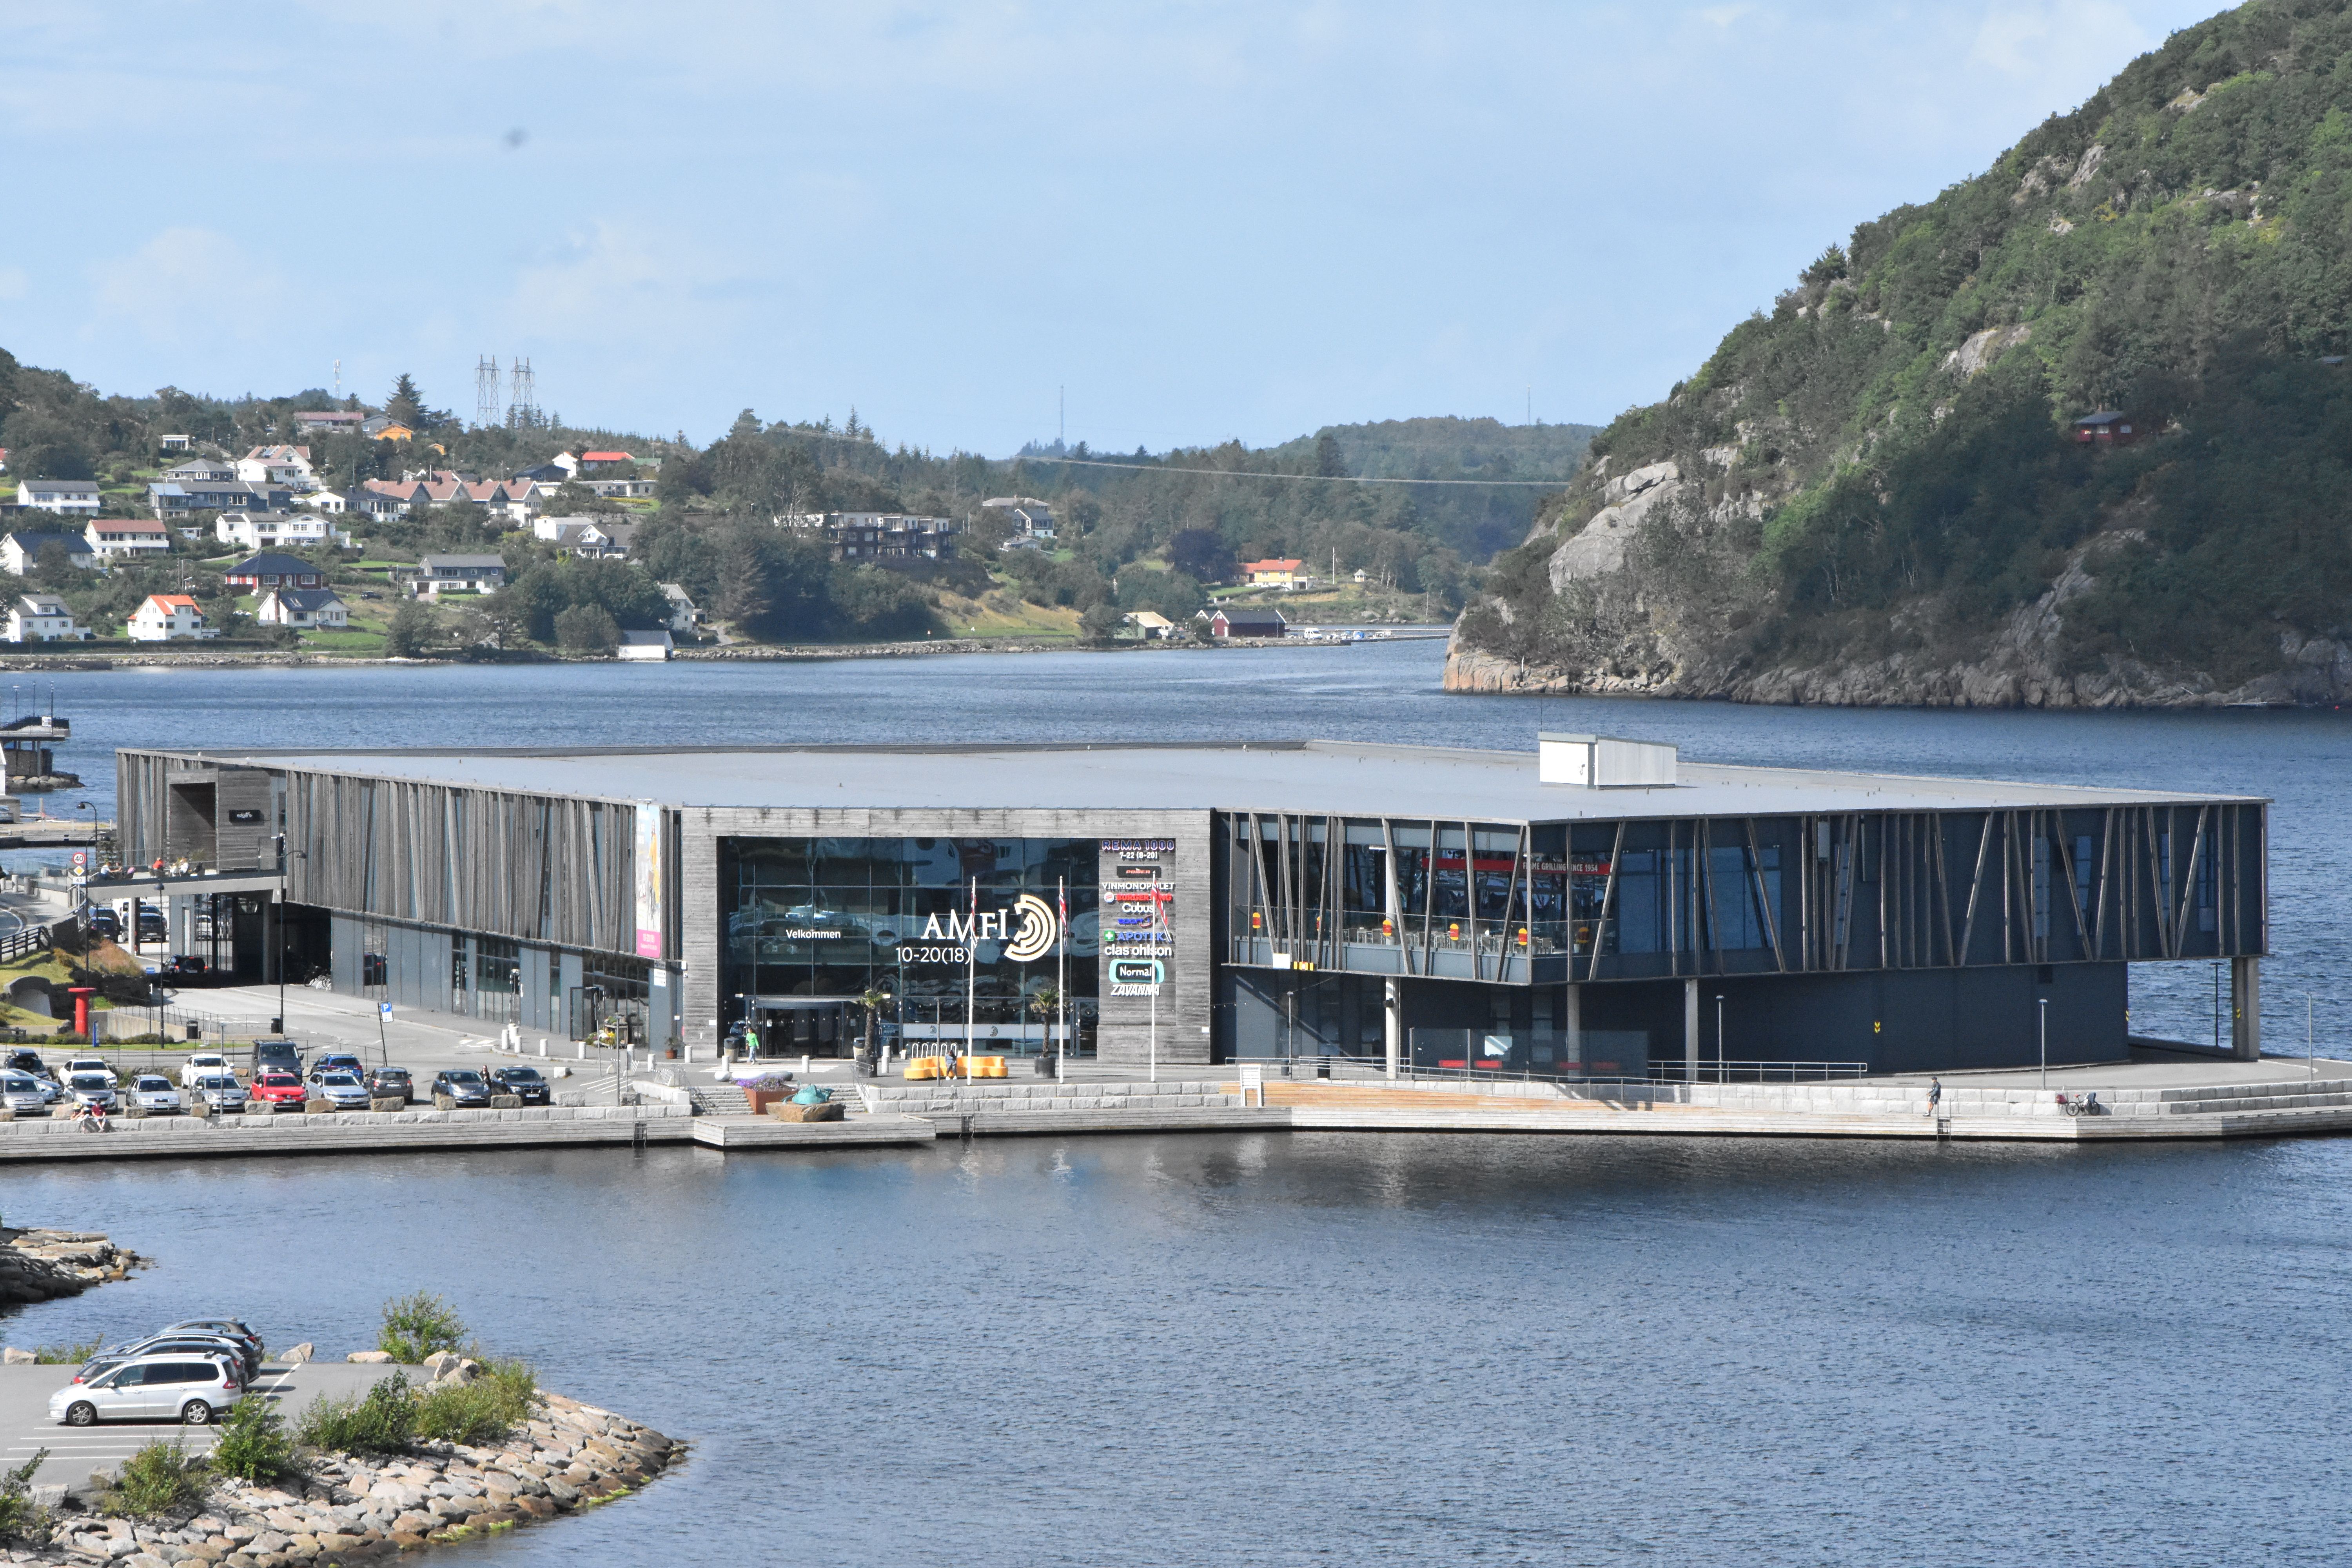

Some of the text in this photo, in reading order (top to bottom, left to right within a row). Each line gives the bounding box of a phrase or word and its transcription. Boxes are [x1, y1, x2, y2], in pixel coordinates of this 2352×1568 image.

[1102, 840, 1174, 850] REMA 1000
[1541, 862, 1566, 871] GRILLING
[1122, 902, 1154, 913] Cubus
[920, 909, 1009, 943] AMFI
[786, 929, 841, 939] Velkommen
[1104, 944, 1172, 956] clas ohlson
[896, 947, 971, 965] 10-20(18)
[1120, 965, 1152, 976] Normal
[1110, 984, 1160, 996] ZAVANNA
